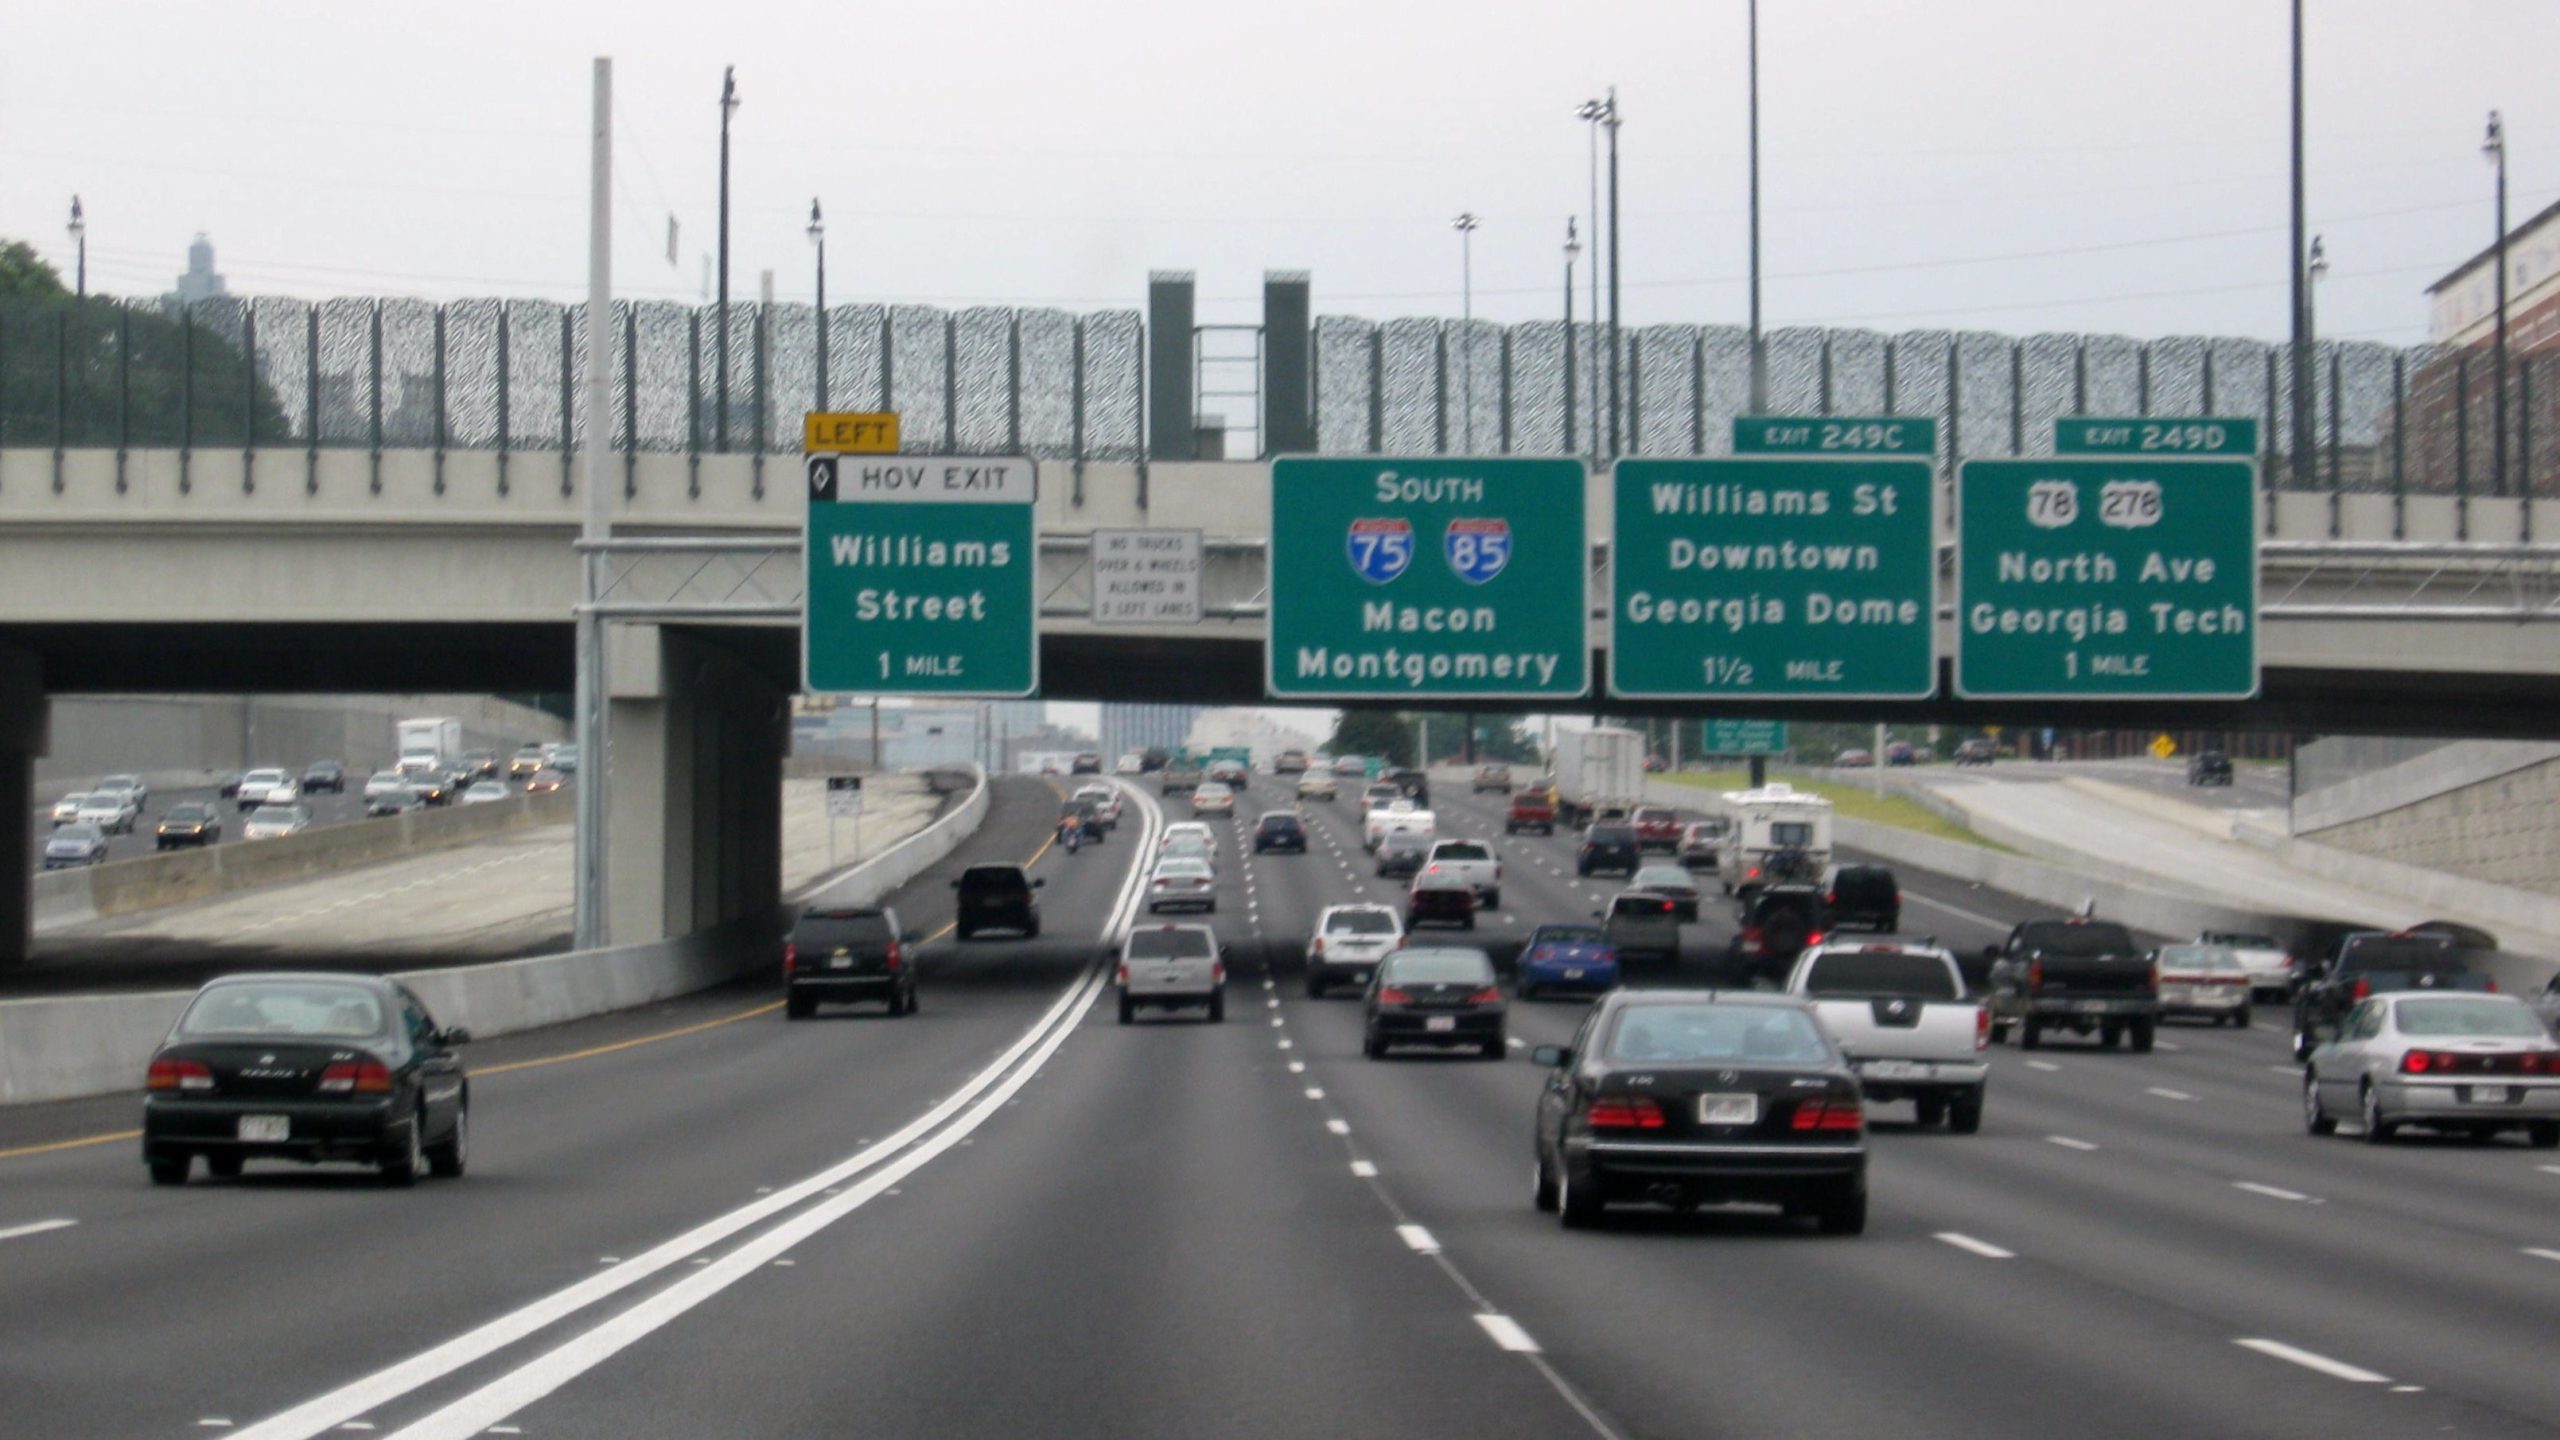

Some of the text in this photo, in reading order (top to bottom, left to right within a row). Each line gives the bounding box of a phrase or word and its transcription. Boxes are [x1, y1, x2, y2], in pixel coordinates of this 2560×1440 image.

[815, 421, 889, 445] LEFT
[1764, 424, 1903, 449] EXIT 249C
[2086, 425, 2226, 450] EXIT 249D
[862, 466, 1008, 490] HOV EXIT
[1376, 471, 1484, 503] SOUTH
[1651, 483, 1898, 515] Williams St
[2033, 490, 2160, 518] 78 278
[831, 535, 1010, 567] Williams
[1110, 538, 1127, 551] NO
[1354, 536, 1506, 571] 75 85
[1670, 539, 1878, 570] Downtown
[1999, 551, 2216, 583] North Ave
[856, 589, 986, 621] Street
[1363, 601, 1495, 632] Macon
[1627, 592, 1920, 632] Georgia Dome
[1970, 603, 2246, 642] Georgia Tech
[878, 652, 963, 679] 1 MILE
[1297, 647, 1559, 687] Montgomery
[1785, 660, 1843, 681] MILE
[2064, 652, 2150, 679] 1 MILE
